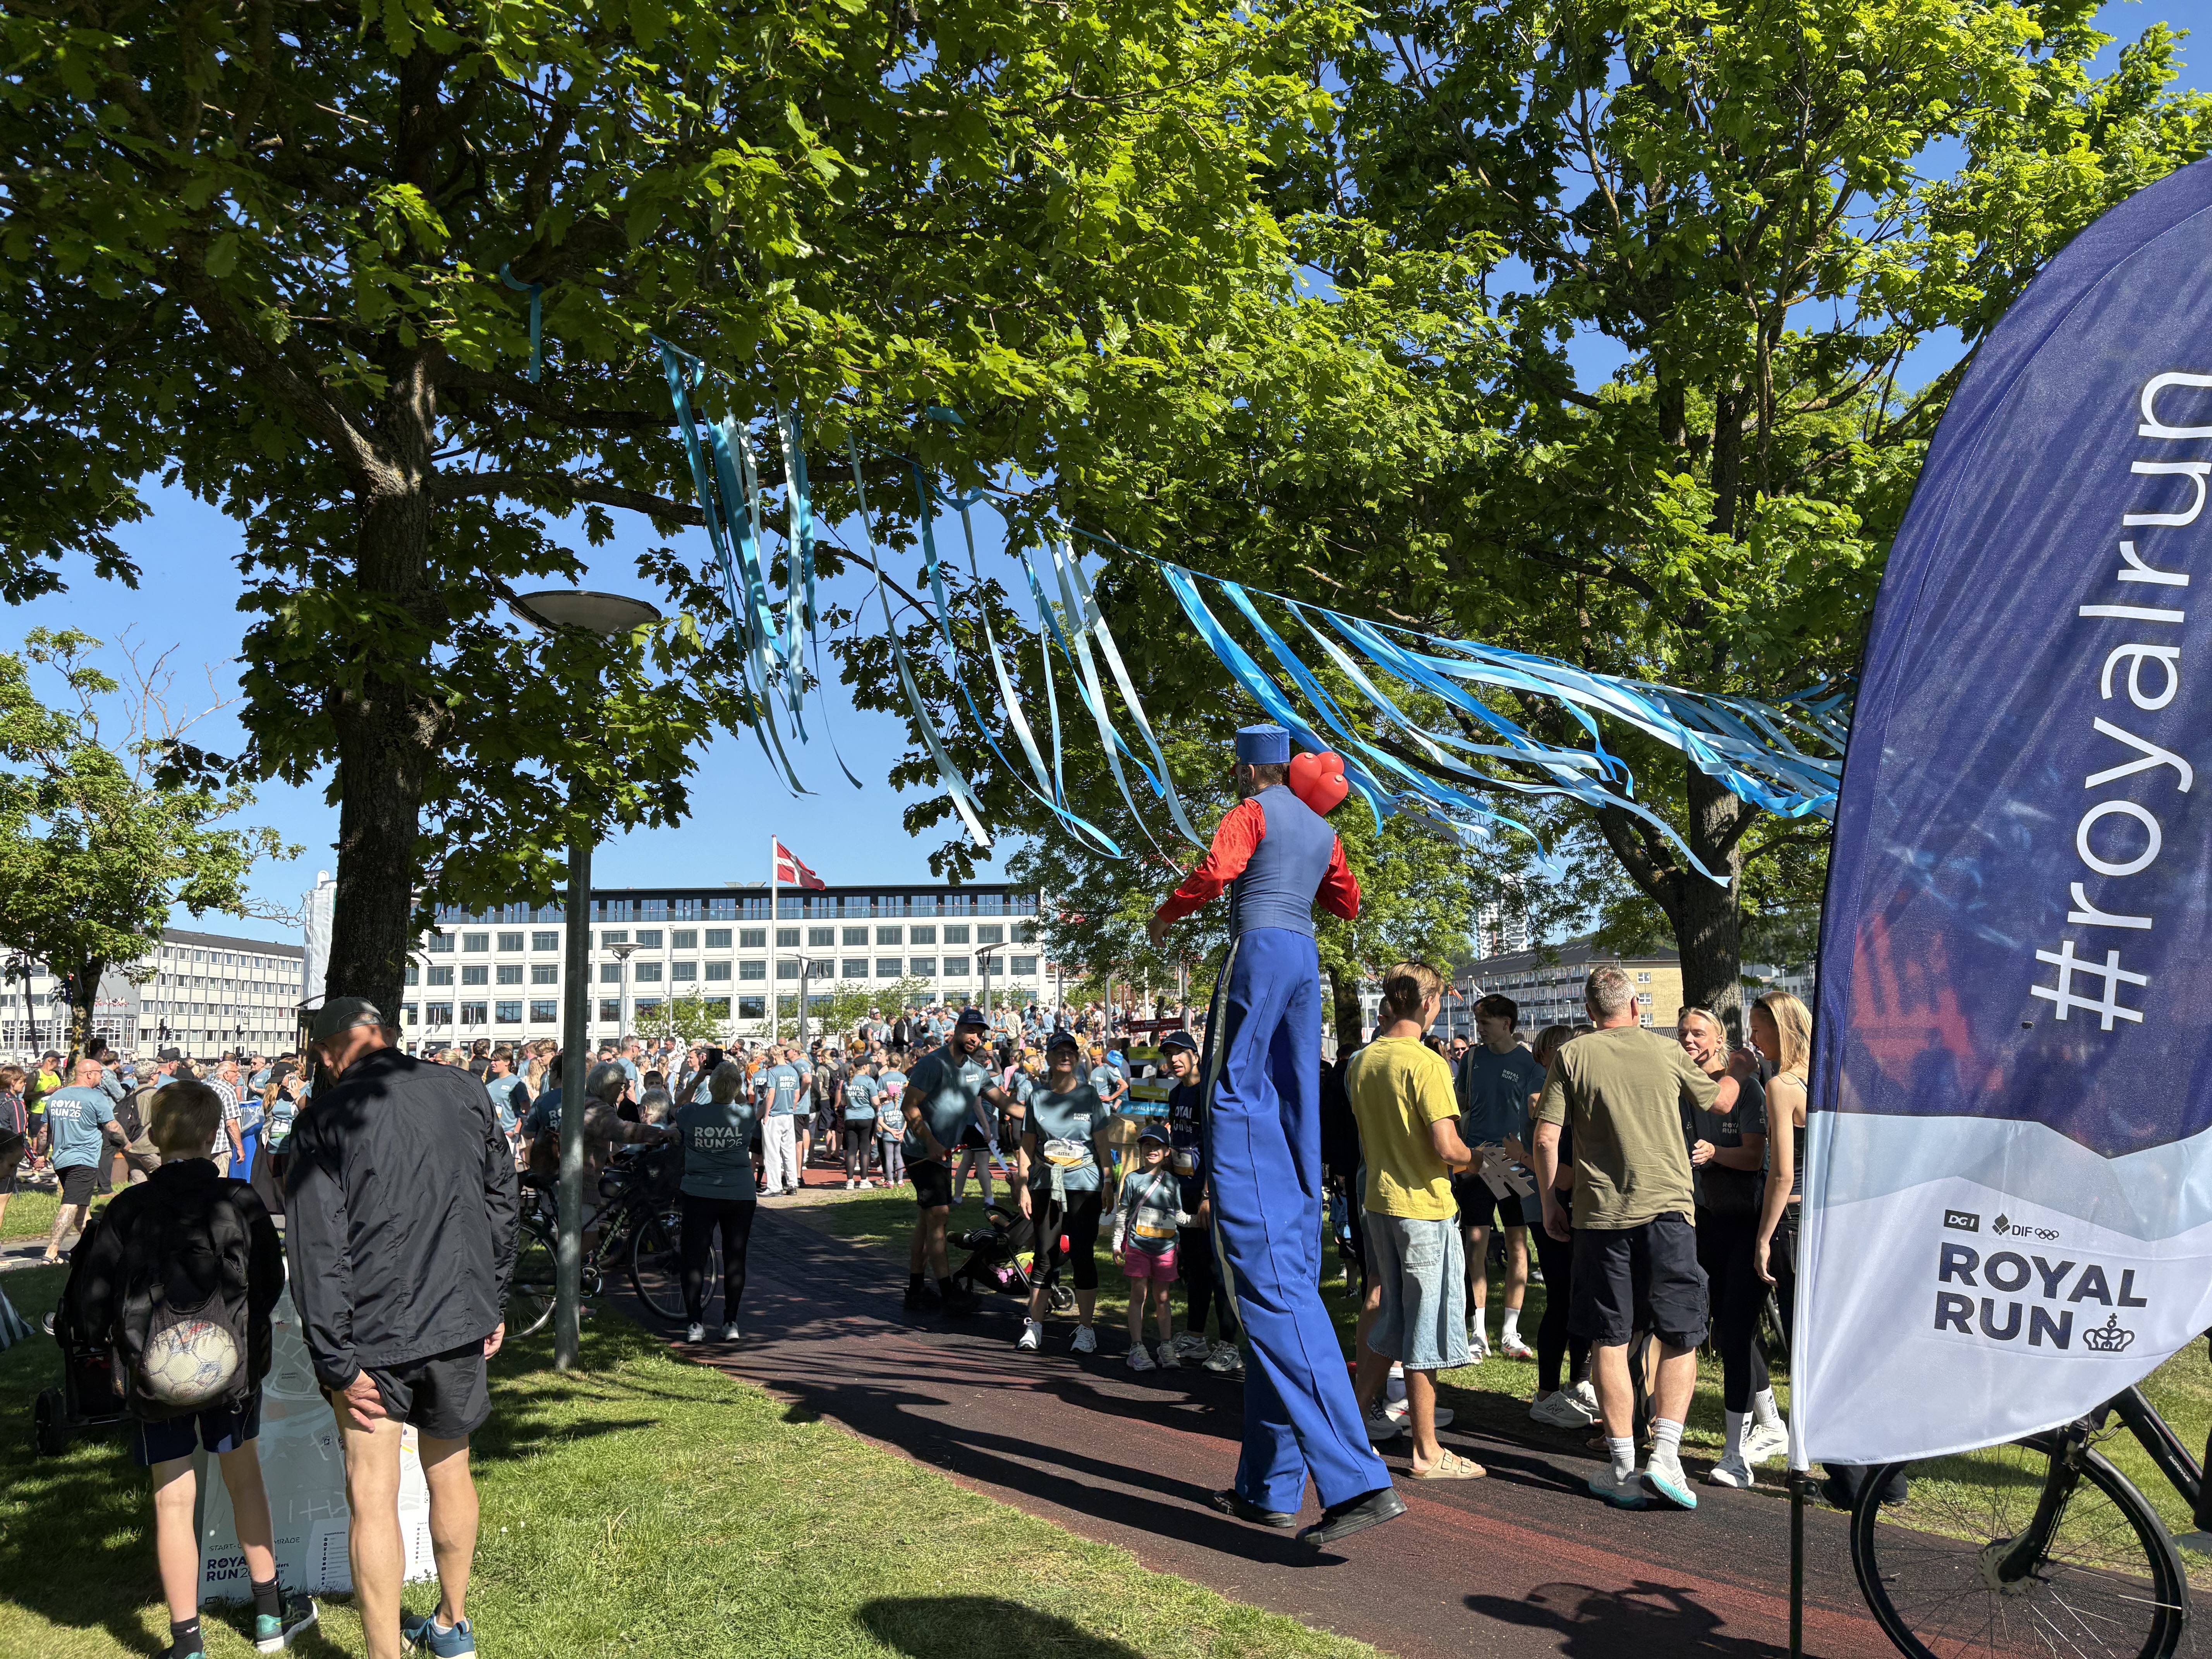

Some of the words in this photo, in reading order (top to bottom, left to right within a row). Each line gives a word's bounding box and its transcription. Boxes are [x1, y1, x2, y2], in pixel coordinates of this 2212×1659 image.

[2031, 371, 2212, 1031] #royalrun
[1503, 1069, 1519, 1079] ROYAL
[51, 1099, 82, 1109] ROYAL
[694, 1127, 743, 1137] ROYAL
[1948, 1214, 1975, 1228] DGI
[2012, 1224, 2033, 1237] DIF
[1938, 1242, 2148, 1308] ROYAL
[1934, 1290, 2074, 1350] RUN
[207, 1556, 247, 1570] ROYA
